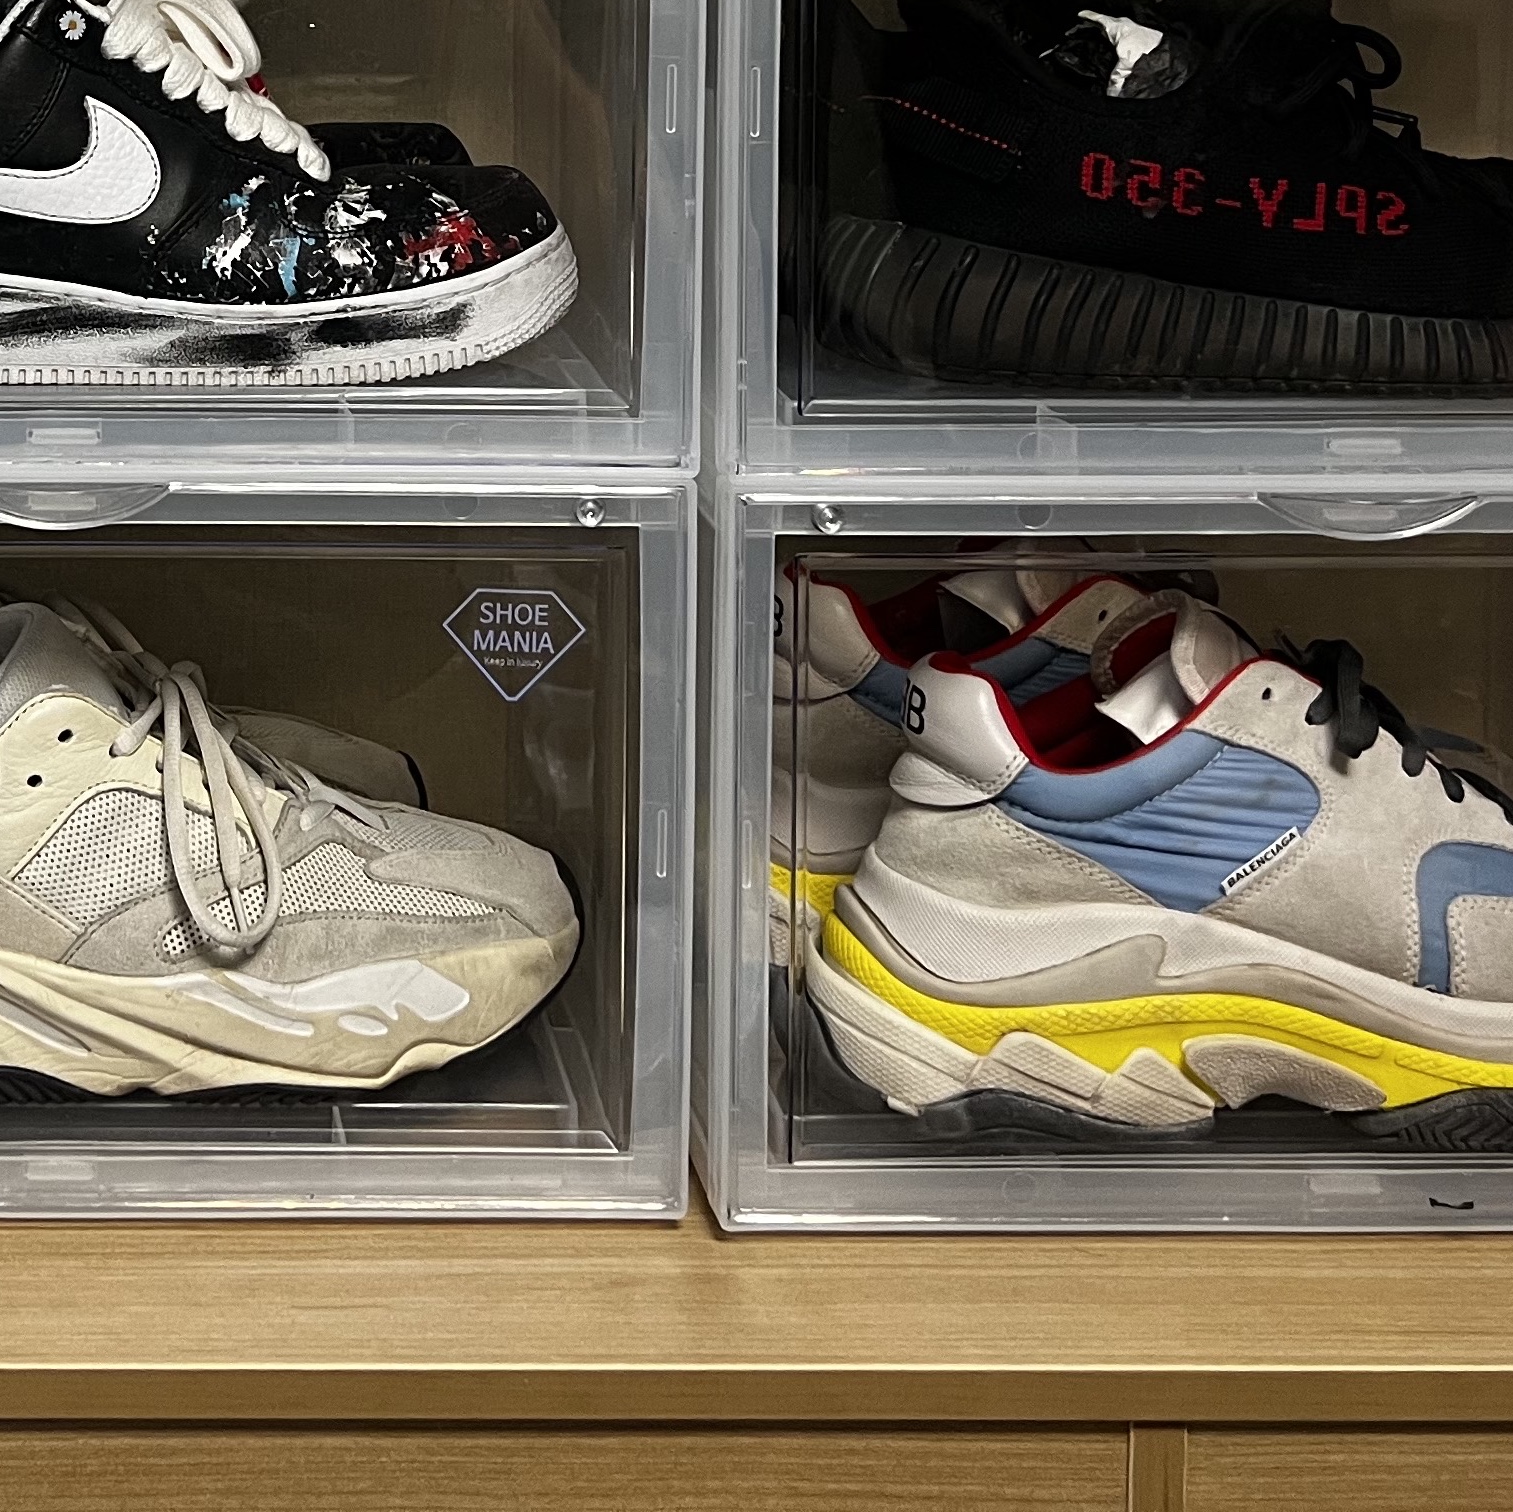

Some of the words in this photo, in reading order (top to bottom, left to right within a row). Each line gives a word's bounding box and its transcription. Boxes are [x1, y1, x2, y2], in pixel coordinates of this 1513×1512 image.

[479, 601, 550, 626] SHOE
[473, 629, 555, 654] MANIA
[1226, 831, 1297, 888] BALENCIAGA
